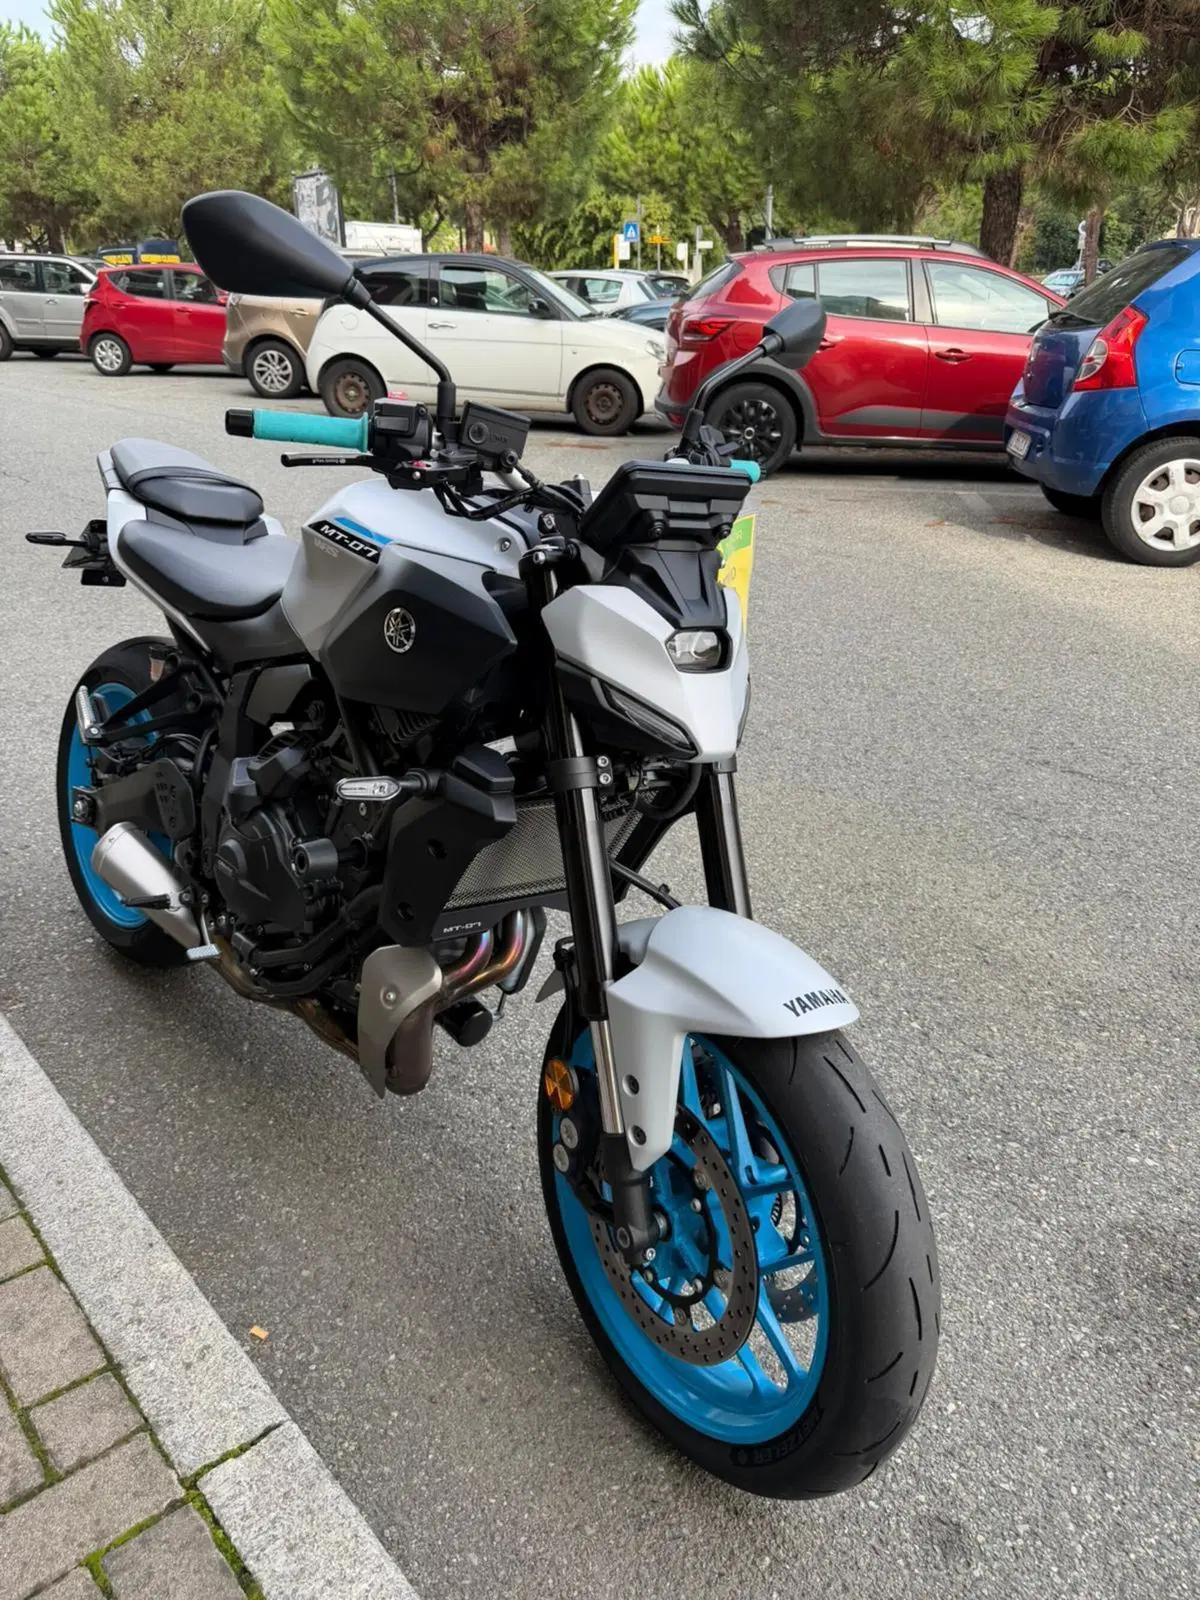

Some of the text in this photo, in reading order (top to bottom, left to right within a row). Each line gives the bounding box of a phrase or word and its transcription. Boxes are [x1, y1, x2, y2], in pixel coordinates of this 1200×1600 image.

[319, 524, 379, 558] MT-07
[442, 921, 482, 934] MT-07
[782, 988, 850, 1018] YAMAHA
